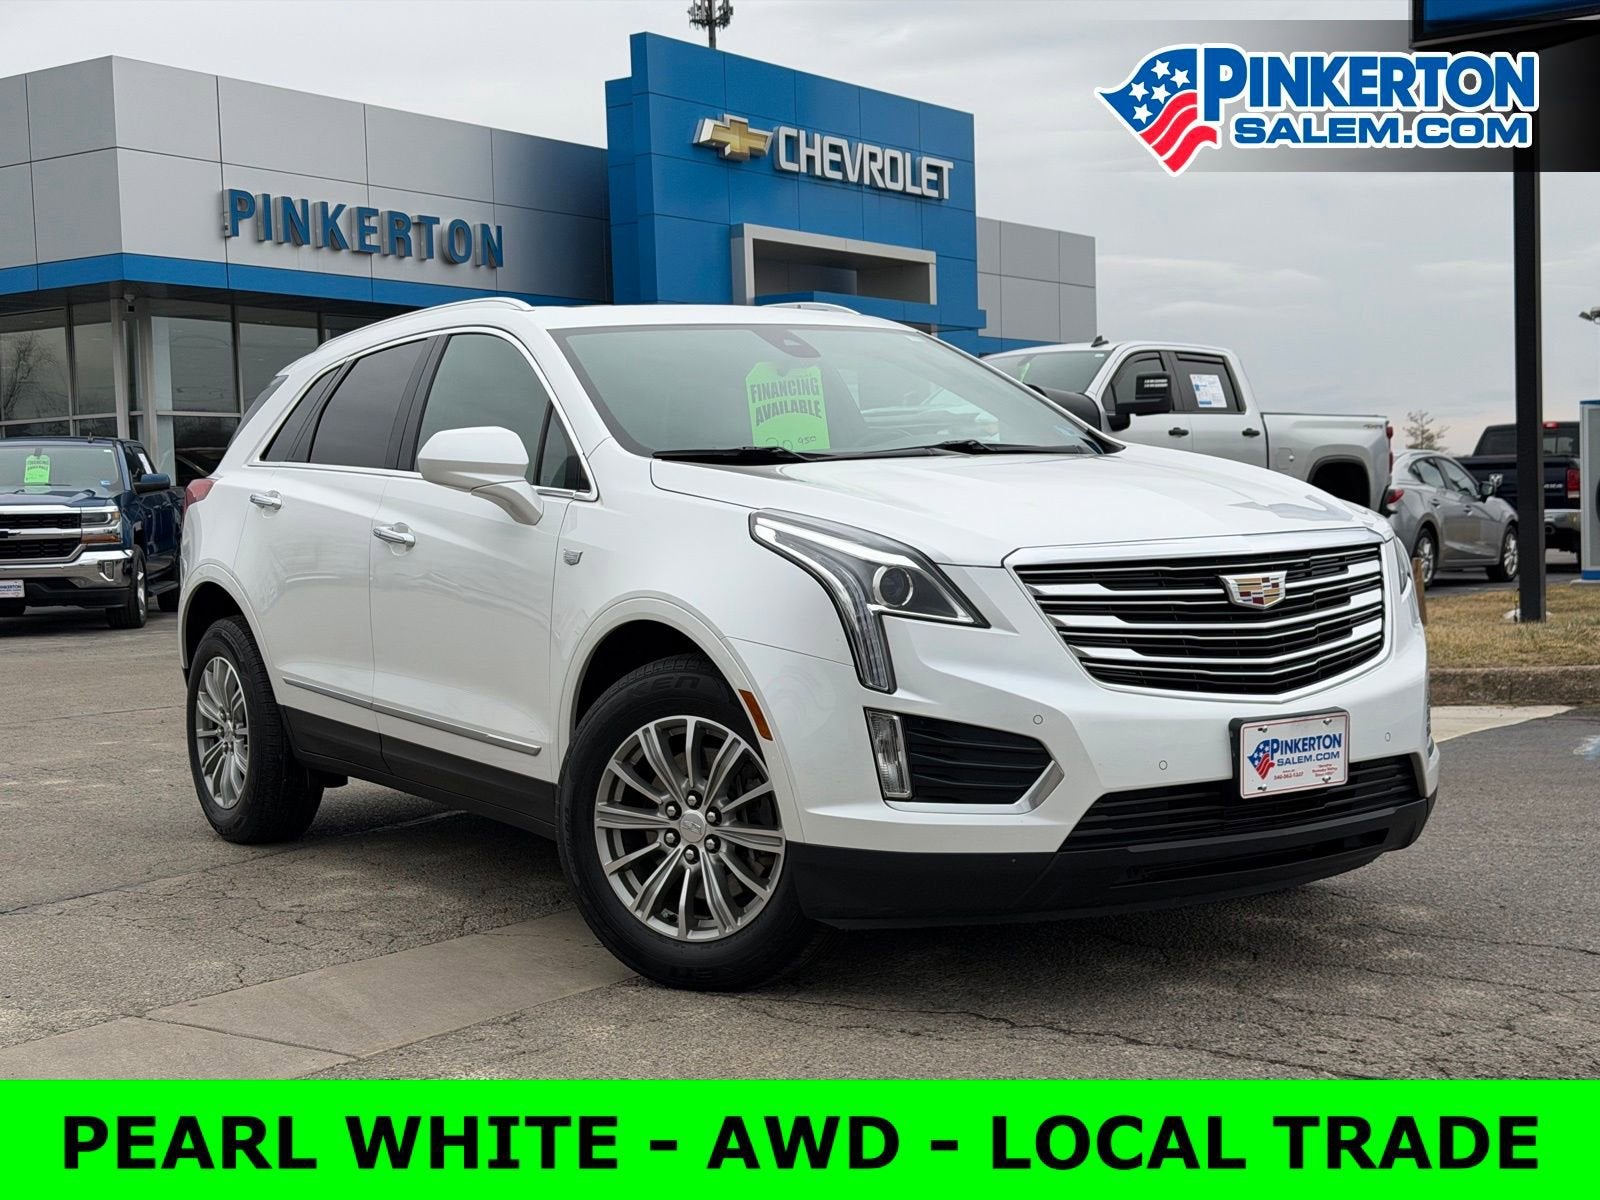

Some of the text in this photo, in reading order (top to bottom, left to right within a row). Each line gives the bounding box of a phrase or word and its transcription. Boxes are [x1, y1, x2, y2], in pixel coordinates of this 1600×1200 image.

[775, 125, 954, 199] CHEVROLET
[224, 188, 504, 268] PINKERTON
[750, 377, 820, 403] FINANCING
[755, 399, 822, 427] AVAILABLE
[1270, 733, 1342, 761] PINKERTON
[1276, 750, 1340, 767] SALEM.COM
